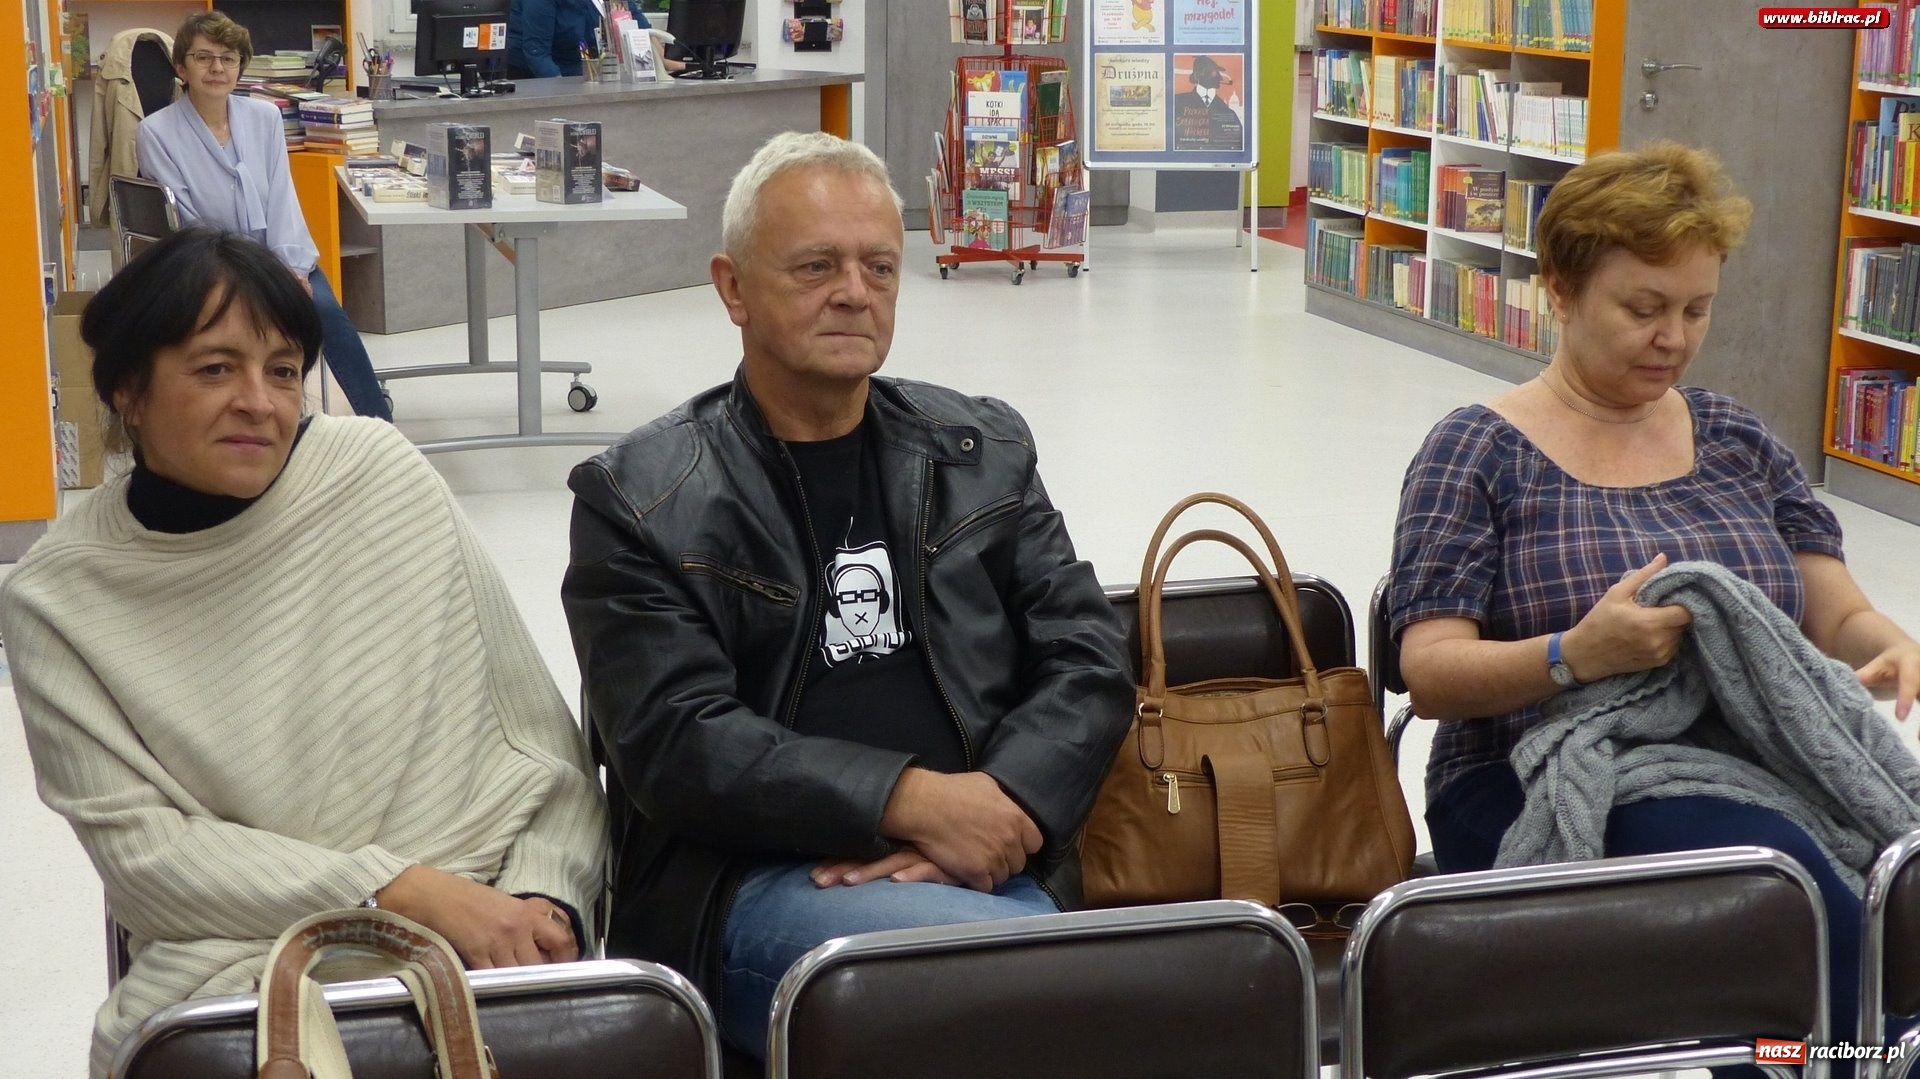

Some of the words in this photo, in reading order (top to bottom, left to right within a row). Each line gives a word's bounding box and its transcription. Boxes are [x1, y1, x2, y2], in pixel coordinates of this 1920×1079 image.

[1184, 8, 1235, 25] przygodo!
[1100, 65, 1159, 80] Drużyna
[985, 100, 1004, 109] KOTKI
[979, 167, 1016, 177] MESSI
